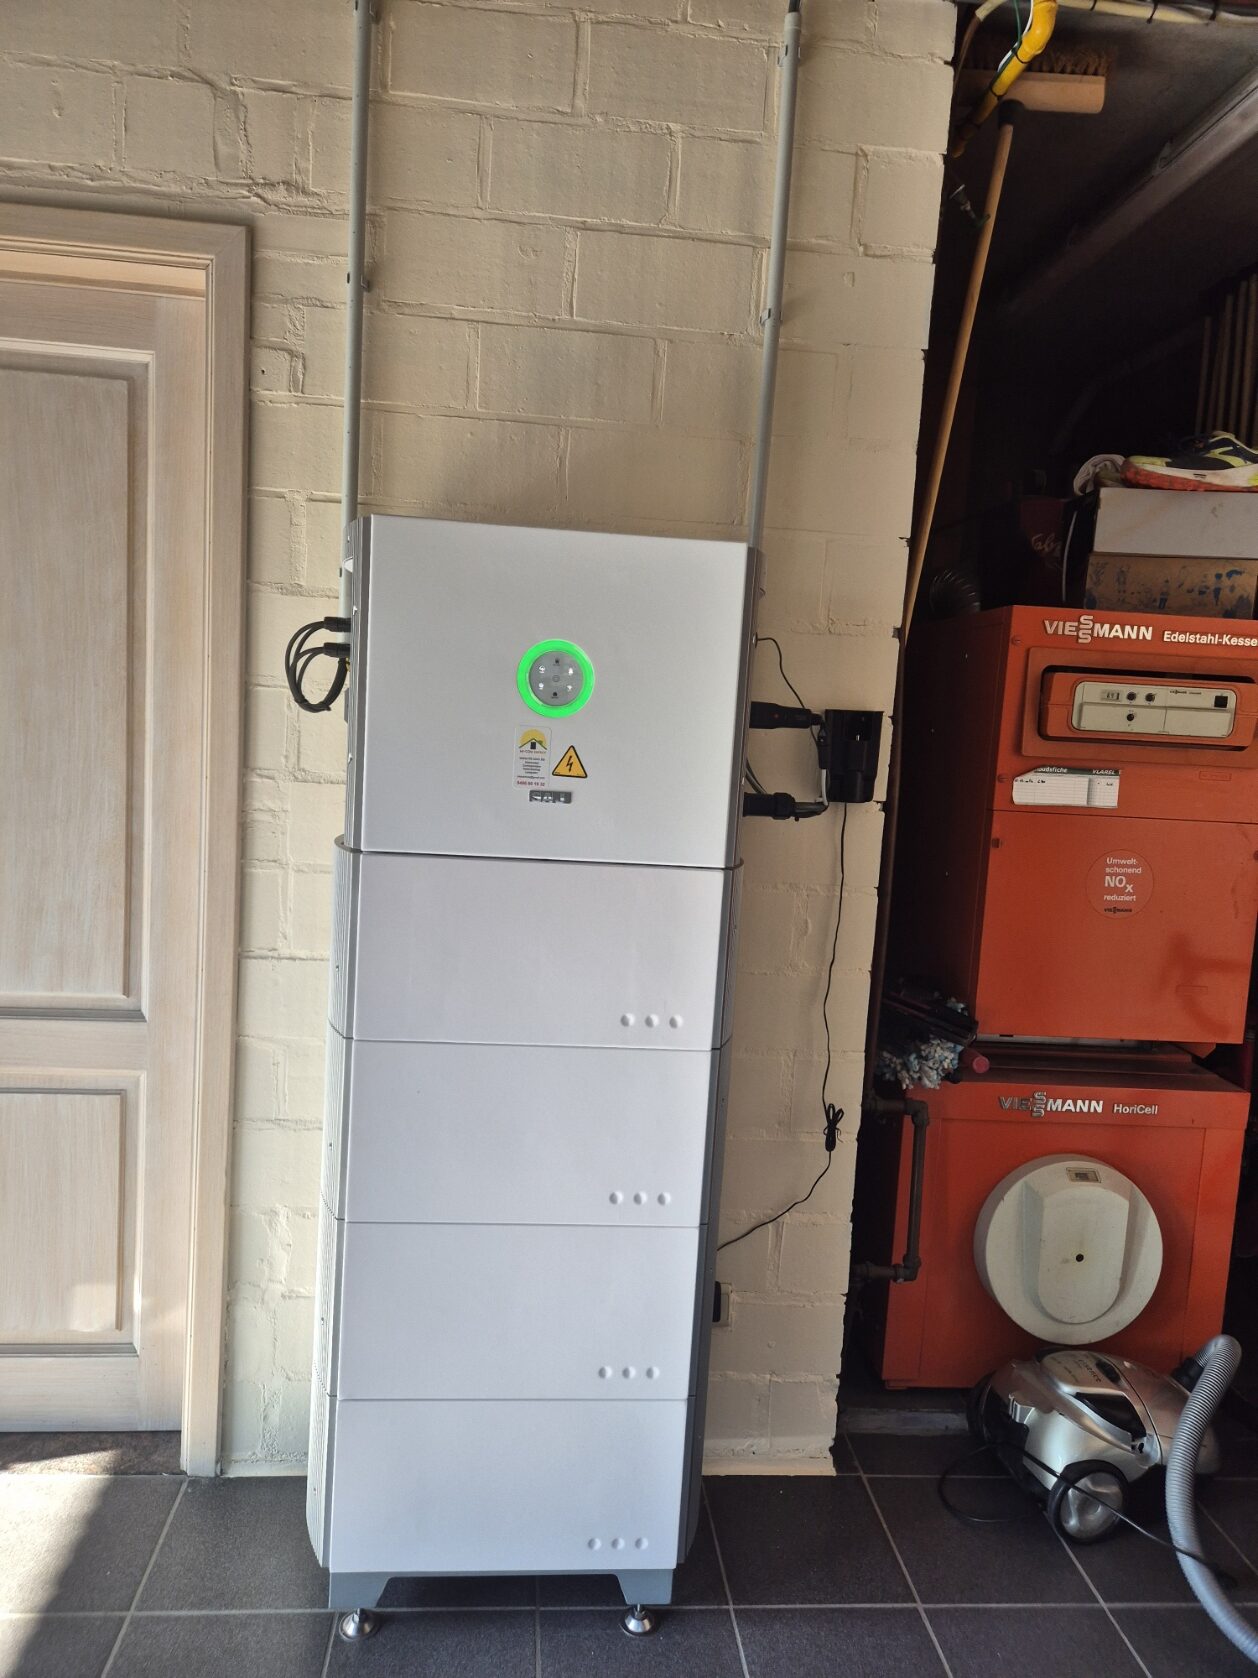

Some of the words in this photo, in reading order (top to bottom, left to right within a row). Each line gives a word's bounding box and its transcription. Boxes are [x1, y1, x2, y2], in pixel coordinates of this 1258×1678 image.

[1043, 614, 1153, 644] VIESSMANN
[1163, 630, 1258, 647] Edelstahl-Kesse
[1105, 866, 1142, 874] schonend
[1103, 894, 1136, 902] reduziert
[1113, 1104, 1159, 1115] HoriCell
